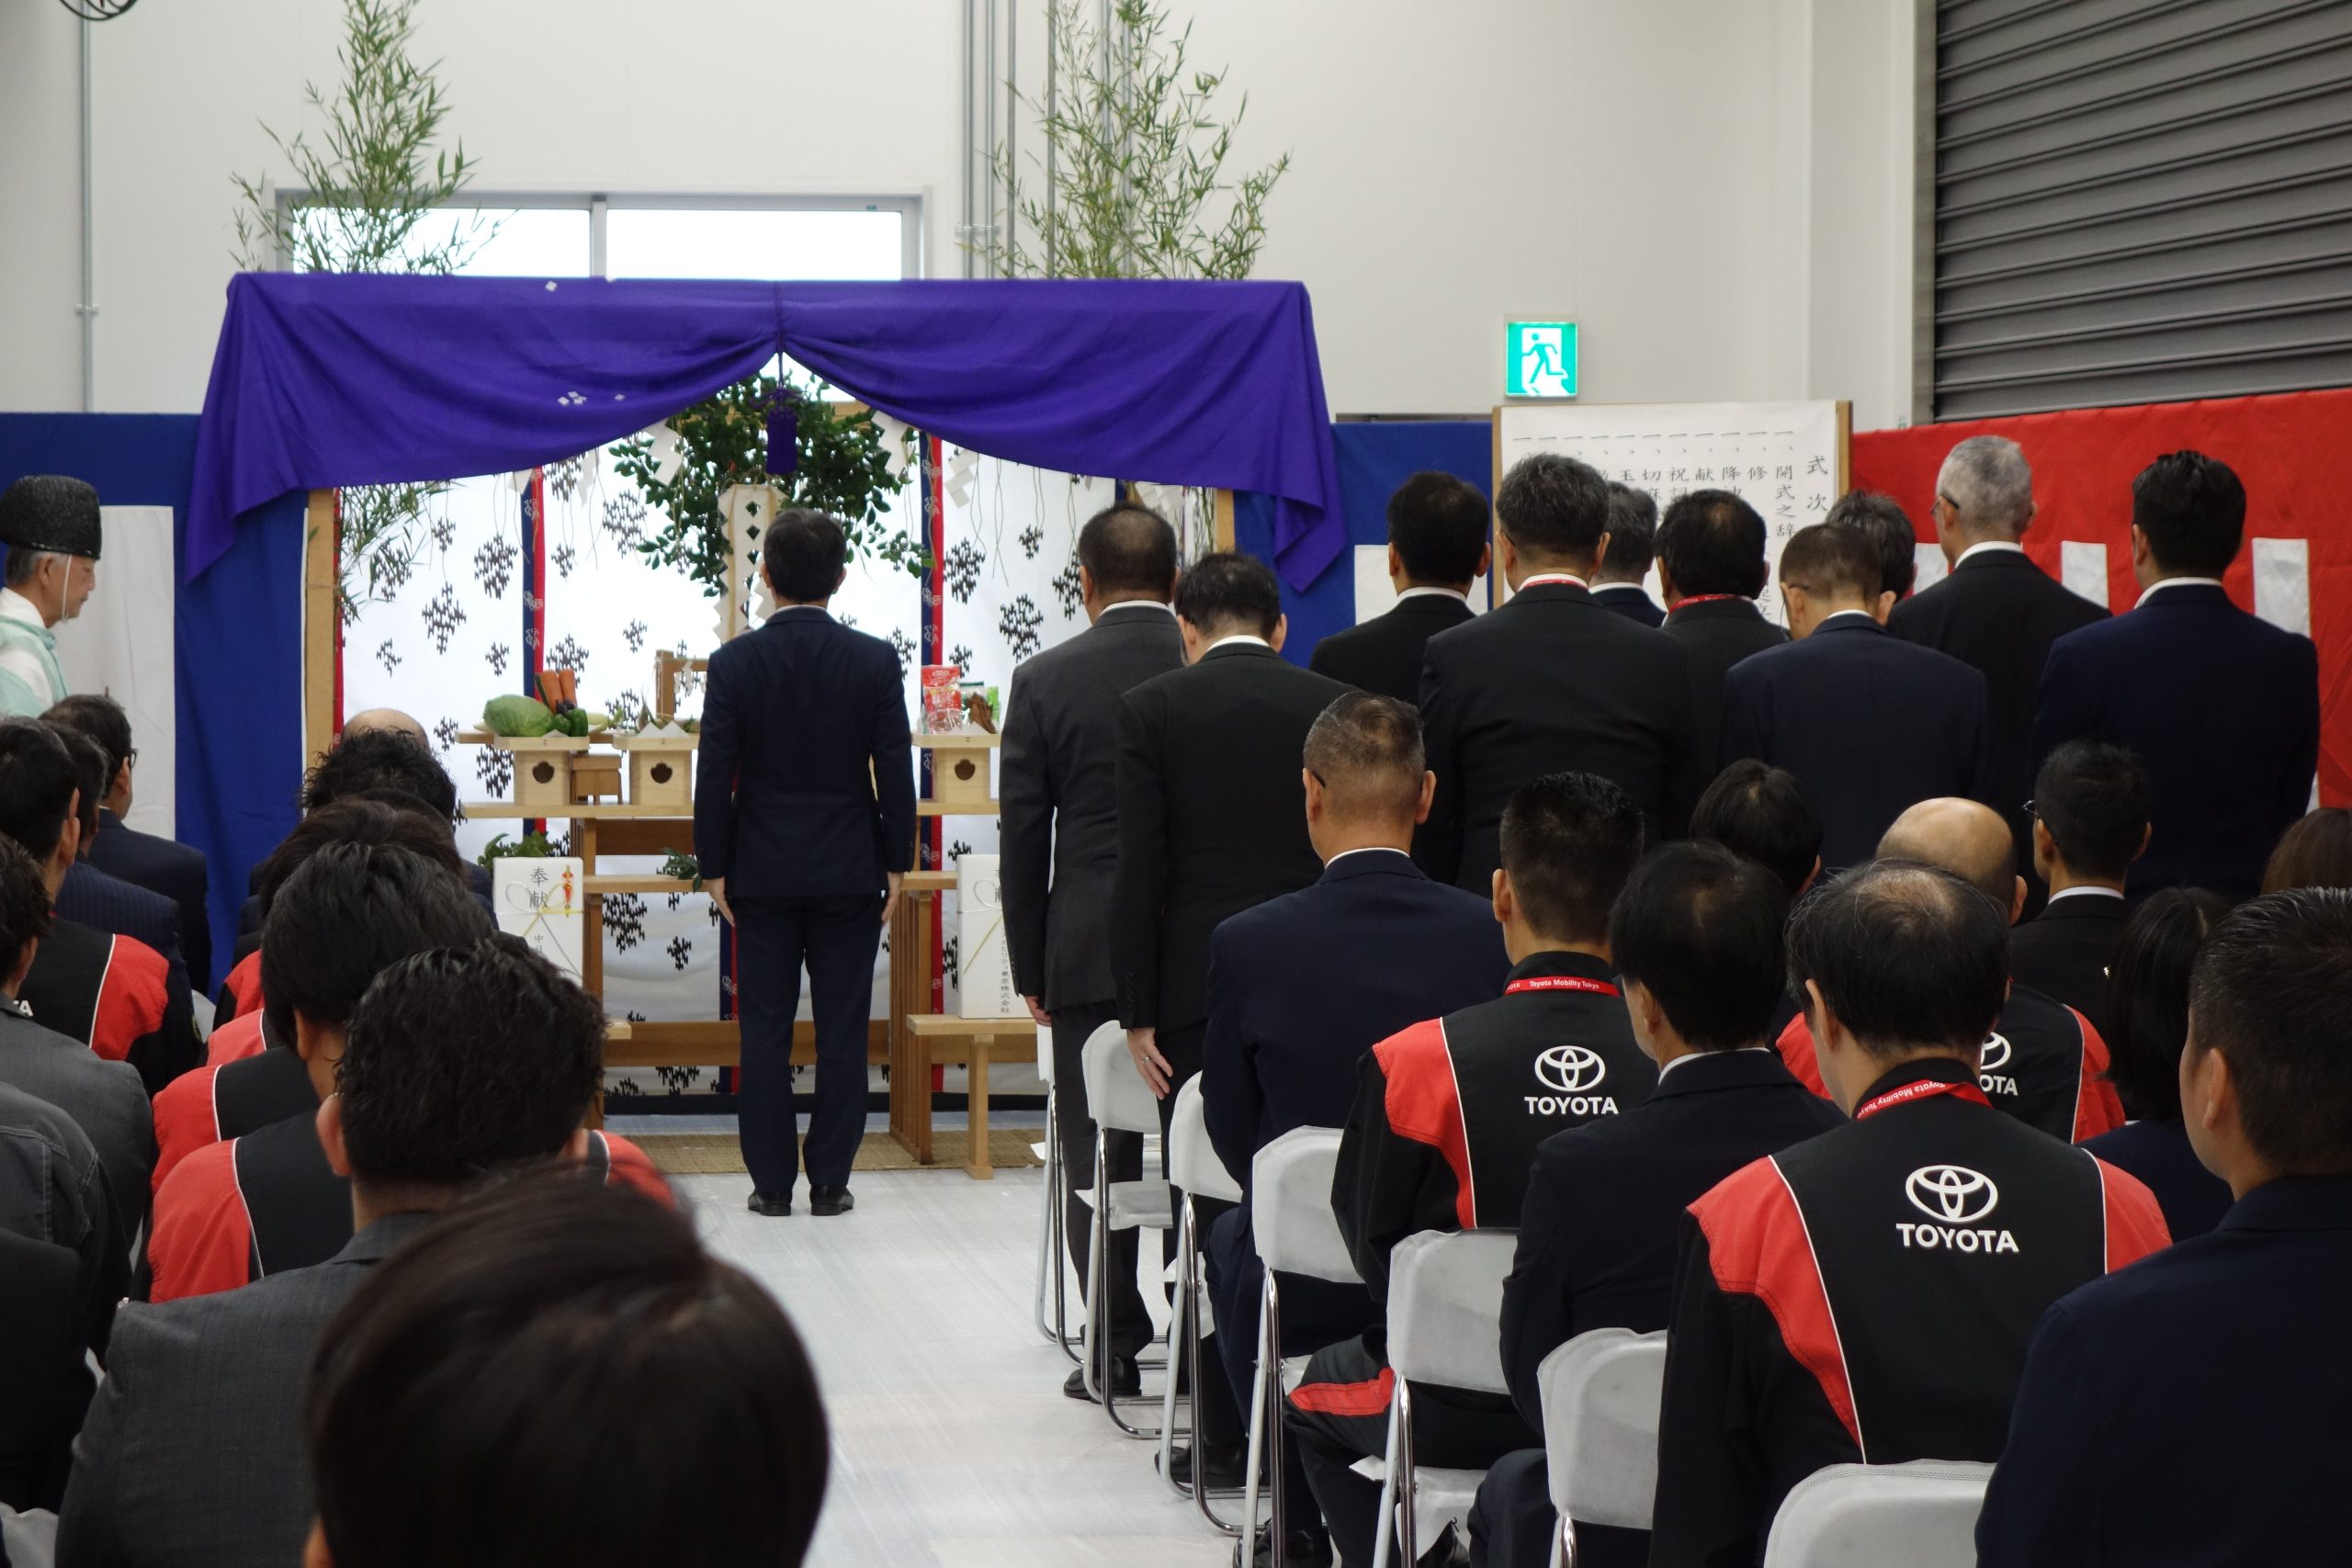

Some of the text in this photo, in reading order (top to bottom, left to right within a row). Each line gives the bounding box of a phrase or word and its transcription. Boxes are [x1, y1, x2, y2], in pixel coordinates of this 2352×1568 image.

[529, 866, 549, 909] 奉献
[1553, 979, 1581, 988] Mobility
[1581, 981, 1600, 989] Tokyo
[1914, 1081, 1946, 1092] Toyota
[1980, 1074, 2018, 1096] OTA
[1878, 1088, 1914, 1105] Mobility
[1524, 1097, 1619, 1114] TOYOTA
[1895, 1223, 2019, 1253] TOYOTA
